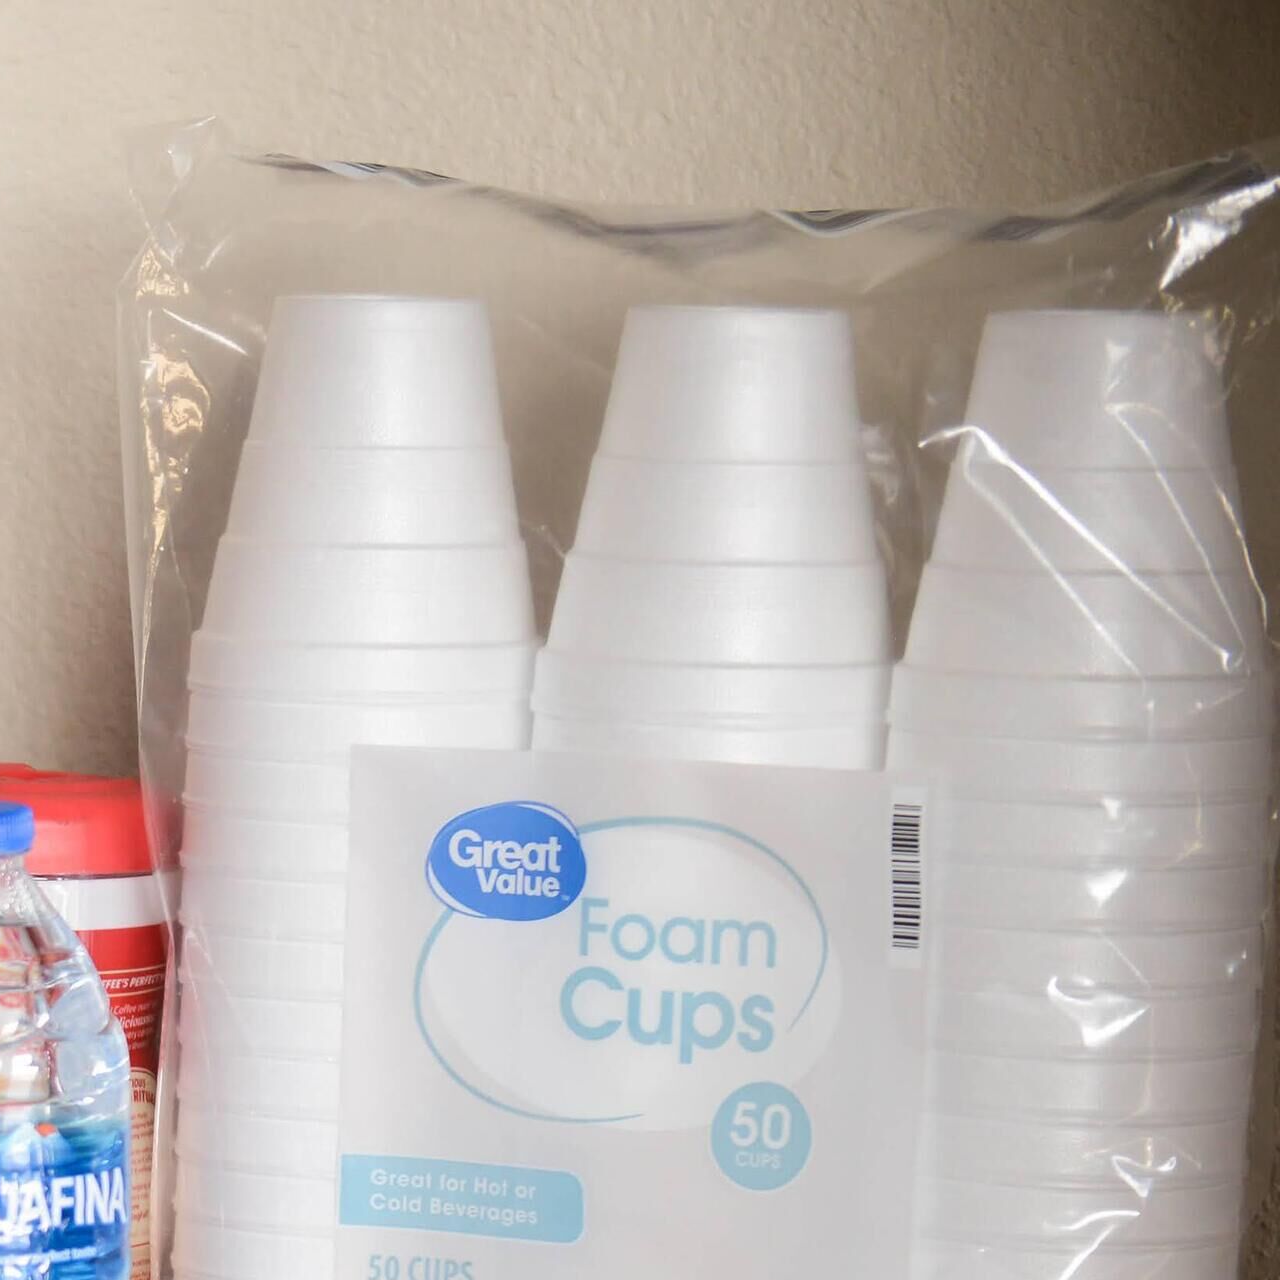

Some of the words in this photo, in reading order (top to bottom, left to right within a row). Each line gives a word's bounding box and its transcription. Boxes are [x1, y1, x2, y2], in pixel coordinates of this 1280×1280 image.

[448, 829, 562, 873] Great
[476, 867, 561, 898] Value
[578, 897, 778, 968] Foam
[559, 965, 775, 1064] Cups
[729, 1102, 791, 1150] 50
[735, 1152, 781, 1169] CUPS
[369, 1168, 432, 1190] Great
[439, 1173, 467, 1193] for
[474, 1176, 509, 1197] Hot
[517, 1183, 536, 1200] or
[369, 1194, 423, 1214] Cold
[429, 1198, 538, 1226] Beverages
